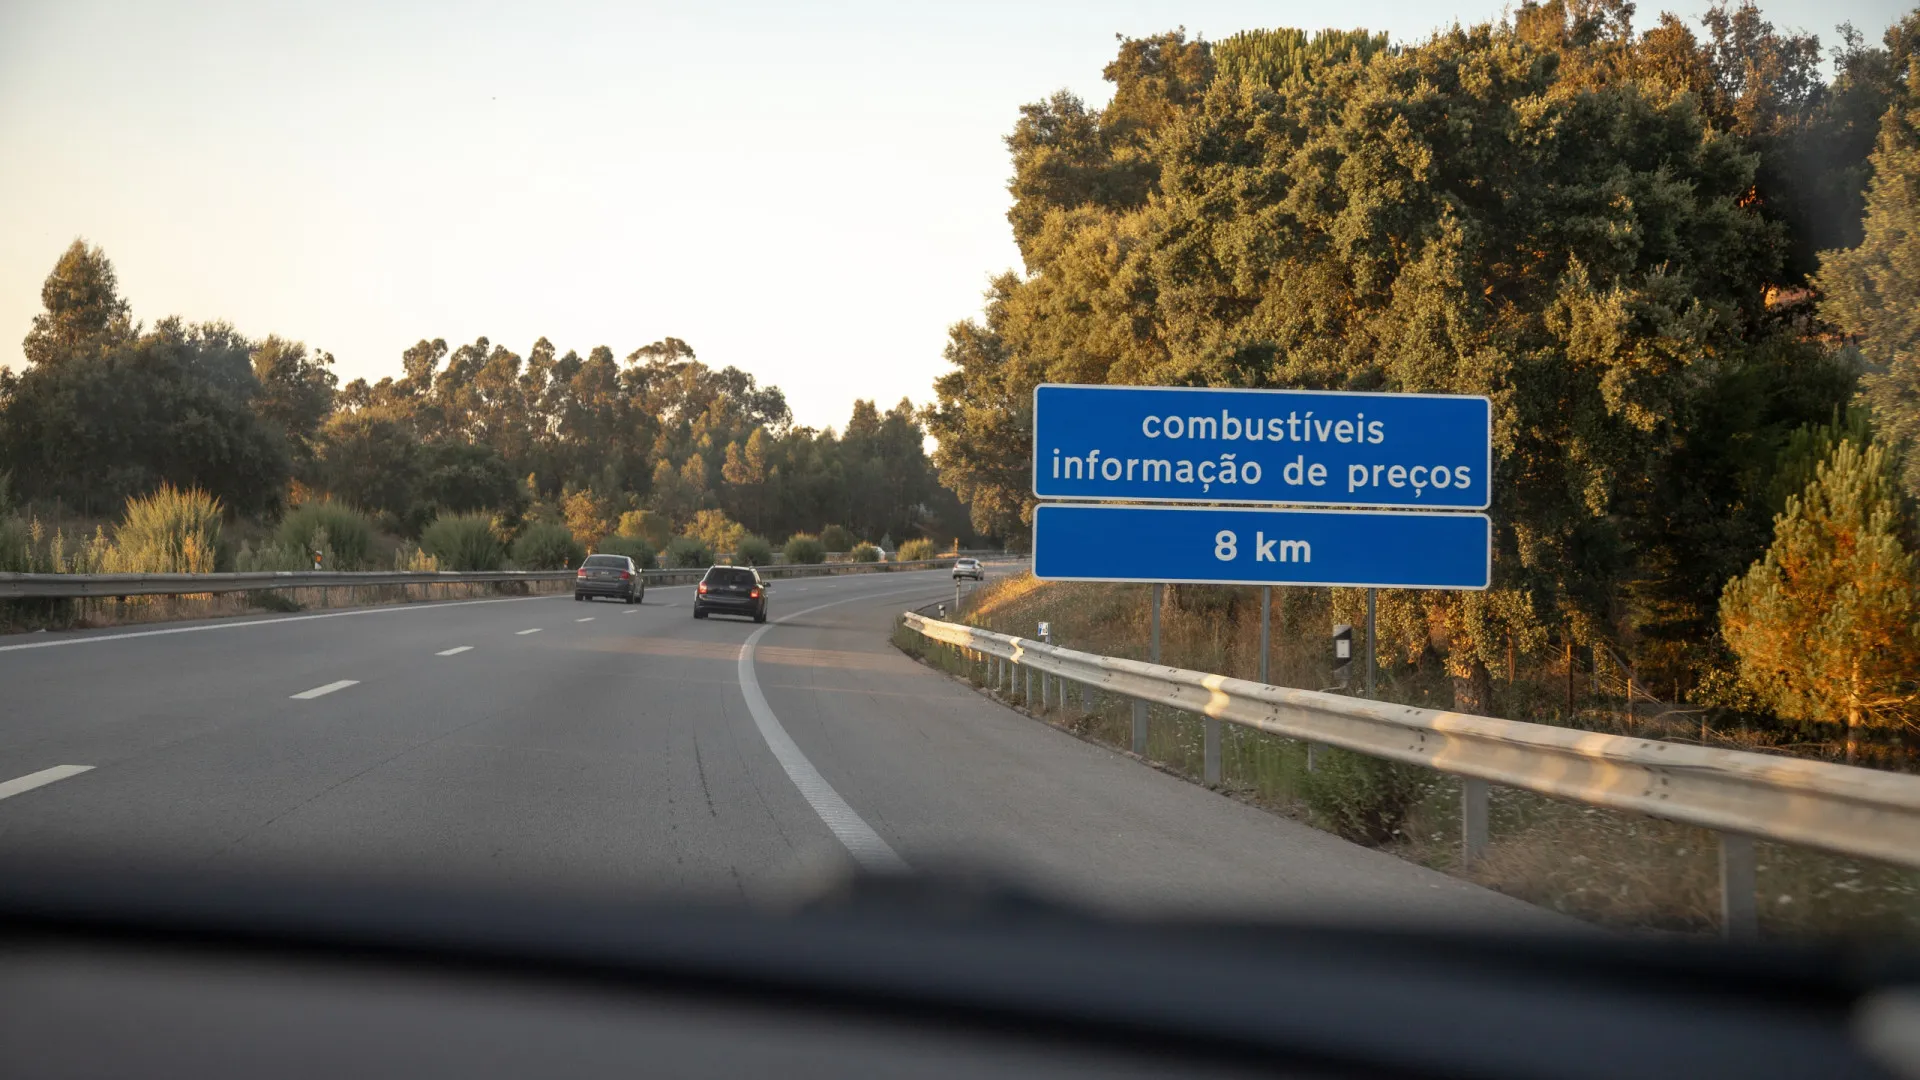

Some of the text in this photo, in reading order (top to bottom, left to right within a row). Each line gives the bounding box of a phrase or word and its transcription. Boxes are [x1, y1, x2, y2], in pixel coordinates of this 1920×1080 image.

[1142, 409, 1385, 444] combustíveis
[1053, 448, 1471, 496] informação de preços
[1214, 530, 1312, 563] 8 km
